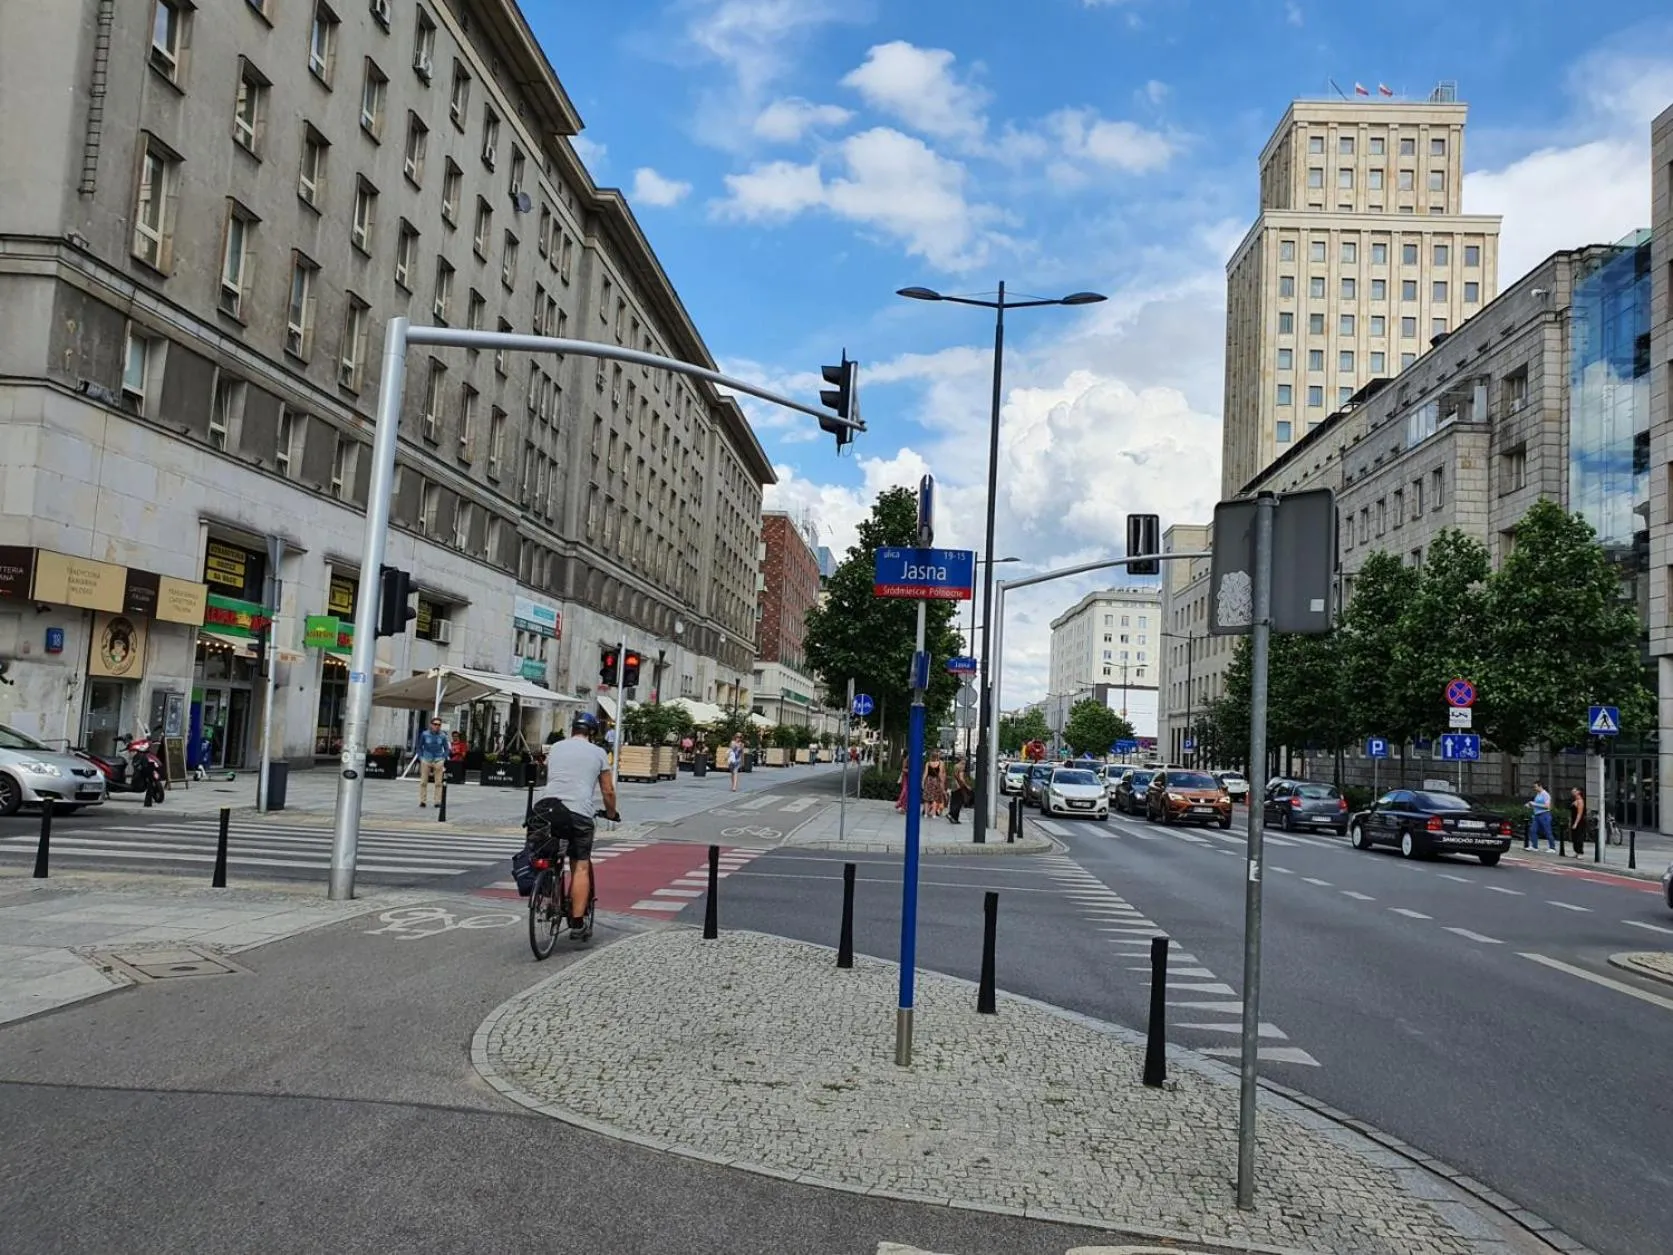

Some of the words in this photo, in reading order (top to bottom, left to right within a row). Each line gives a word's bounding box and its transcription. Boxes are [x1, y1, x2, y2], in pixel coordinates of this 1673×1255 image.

[883, 550, 900, 559] ulica
[943, 552, 966, 561] 19-15
[901, 561, 947, 581] Jasna
[882, 584, 926, 596] Śródmieście
[929, 587, 964, 597] Północne
